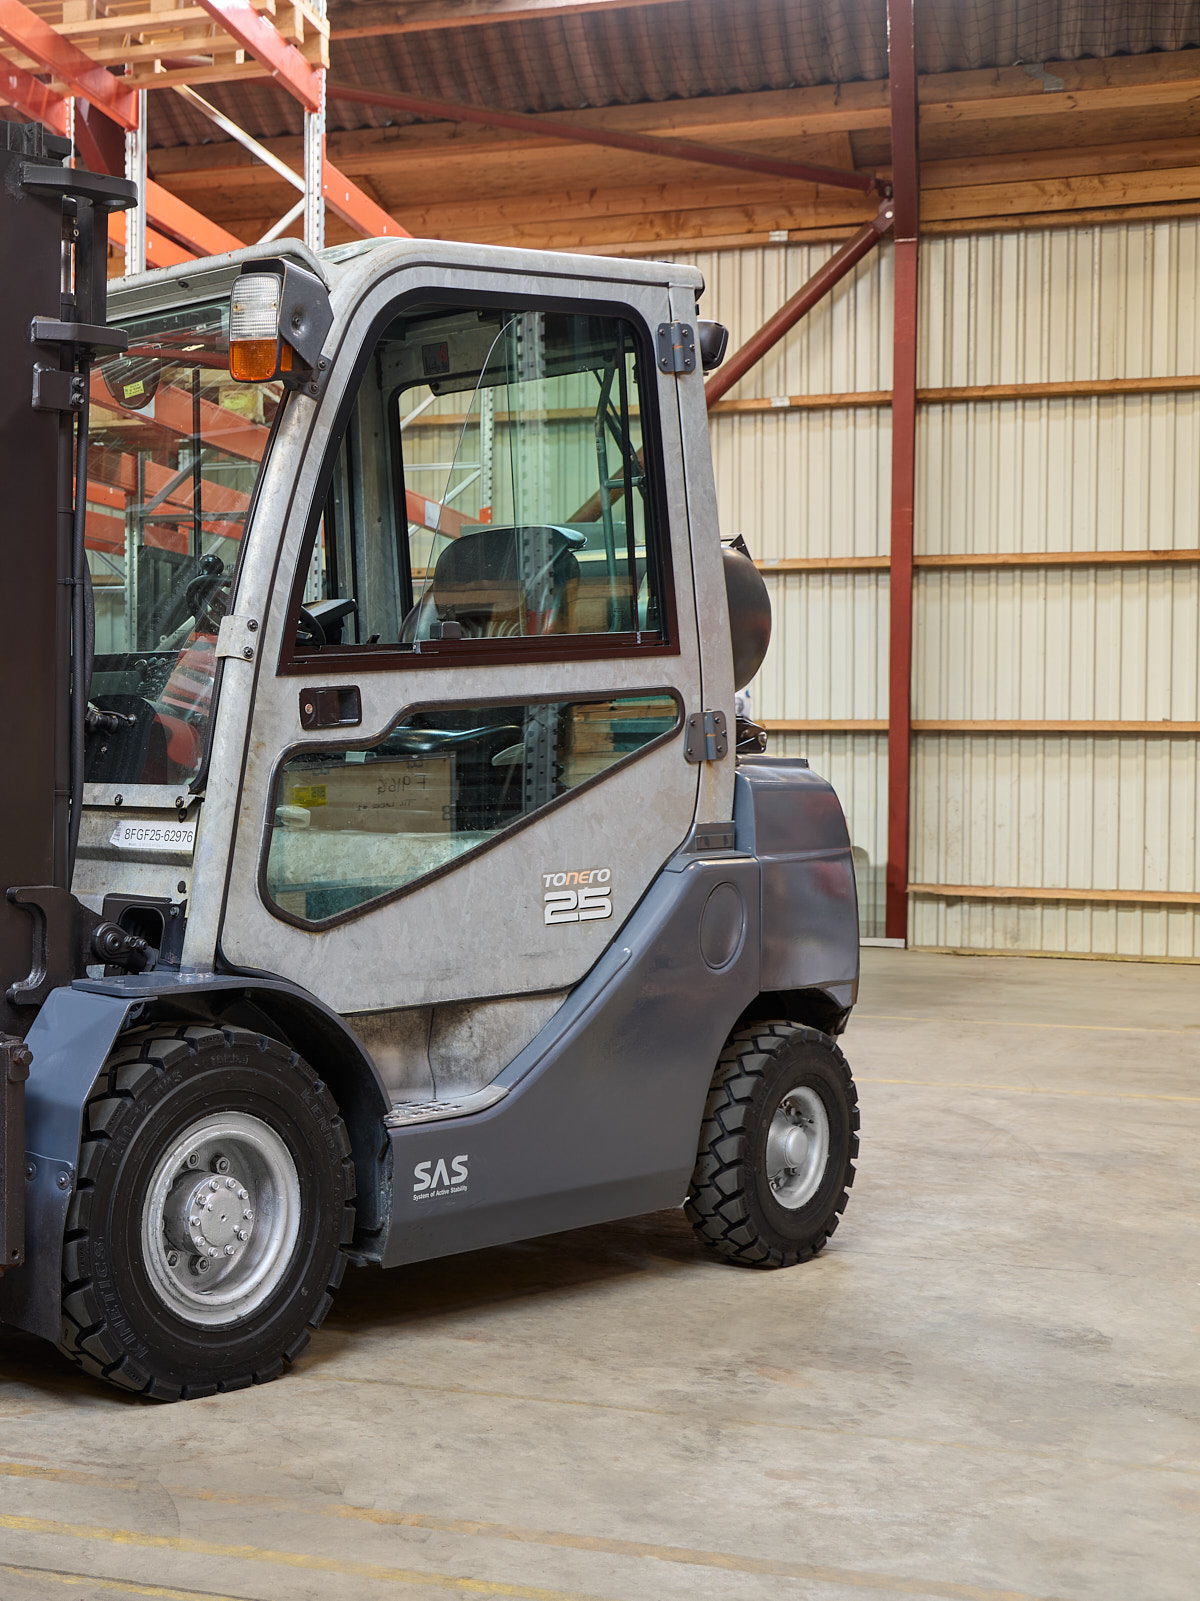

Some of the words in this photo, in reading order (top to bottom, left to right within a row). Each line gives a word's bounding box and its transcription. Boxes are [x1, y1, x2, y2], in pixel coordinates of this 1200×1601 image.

[123, 828, 194, 843] 8FGF25-62976
[544, 886, 613, 926] 25
[413, 1154, 469, 1192] SAS
[412, 1193, 430, 1202] System
[430, 1190, 436, 1198] of
[436, 1189, 450, 1197] Active
[450, 1185, 468, 1194] Stability
